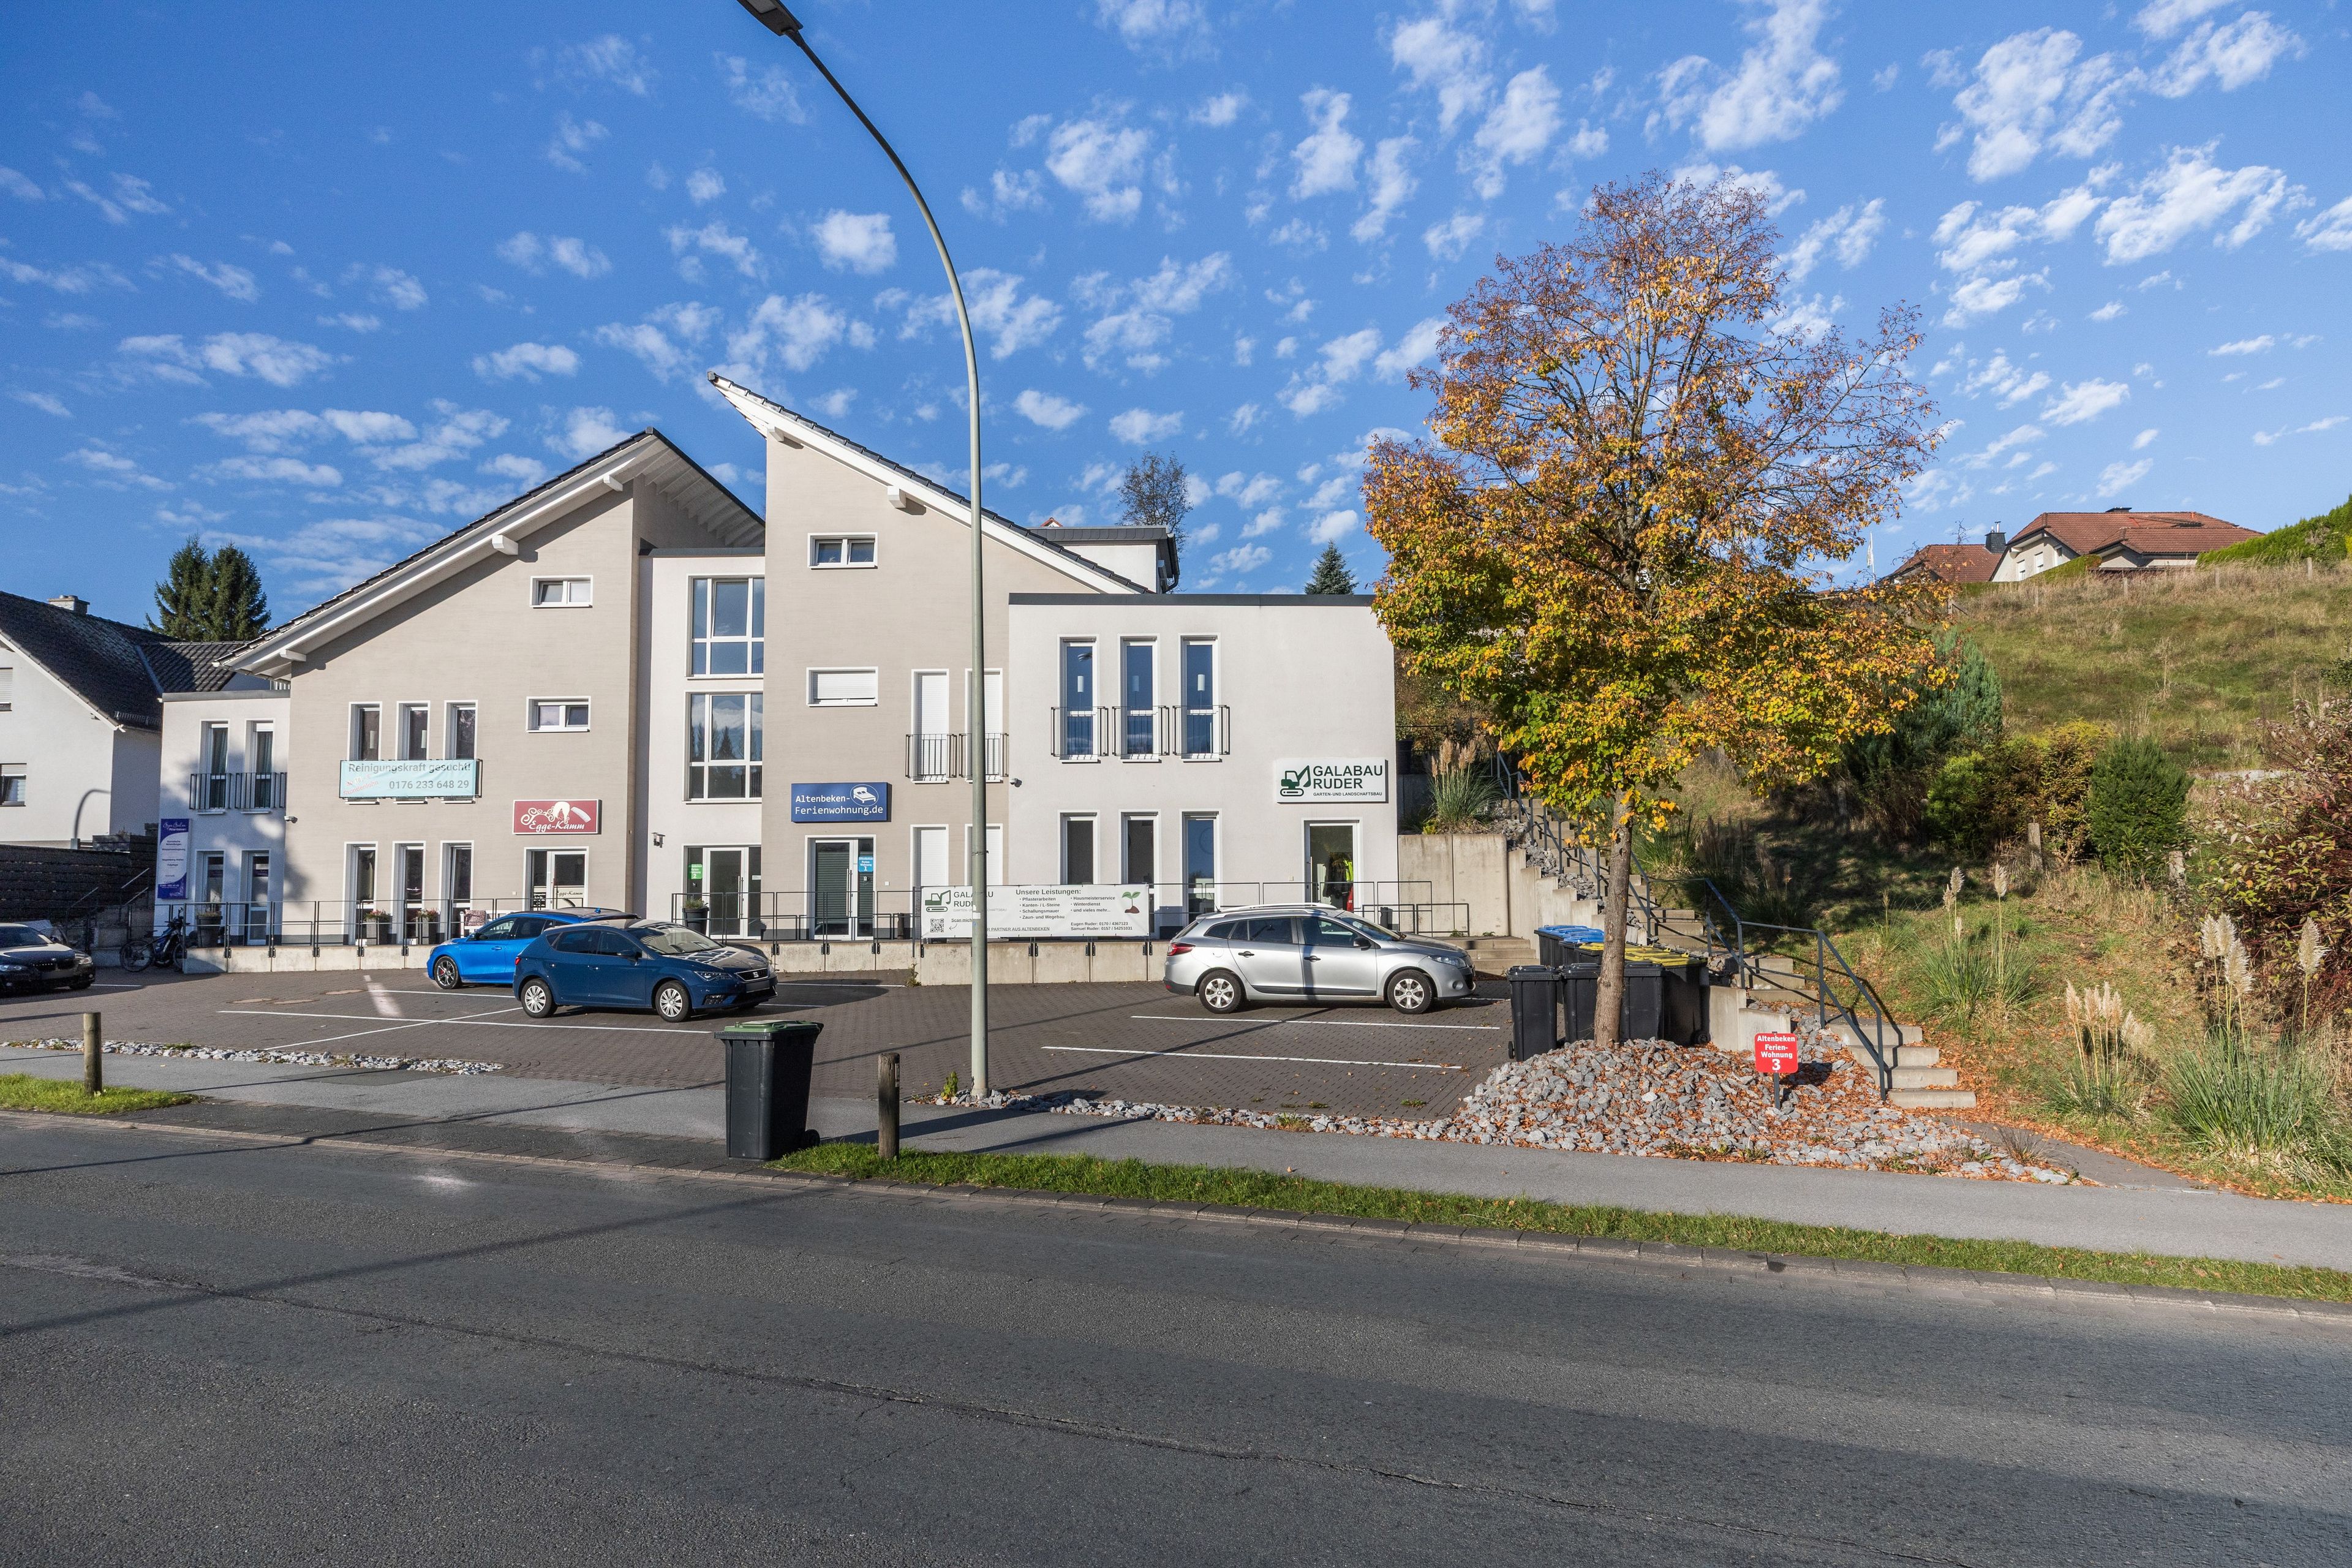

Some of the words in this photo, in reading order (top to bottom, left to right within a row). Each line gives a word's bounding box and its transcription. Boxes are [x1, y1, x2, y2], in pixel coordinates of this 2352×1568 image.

[349, 763, 426, 774] Reinigungskraft
[429, 763, 470, 773] gesucht!
[1313, 766, 1382, 776] GALABAU
[416, 780, 434, 789] 233
[458, 780, 469, 788] 29
[1313, 778, 1363, 789] RUDER
[796, 805, 883, 815] Ferienwohnung.de
[529, 820, 584, 832] Egge-Kamm
[1772, 1058, 1781, 1071] 3
